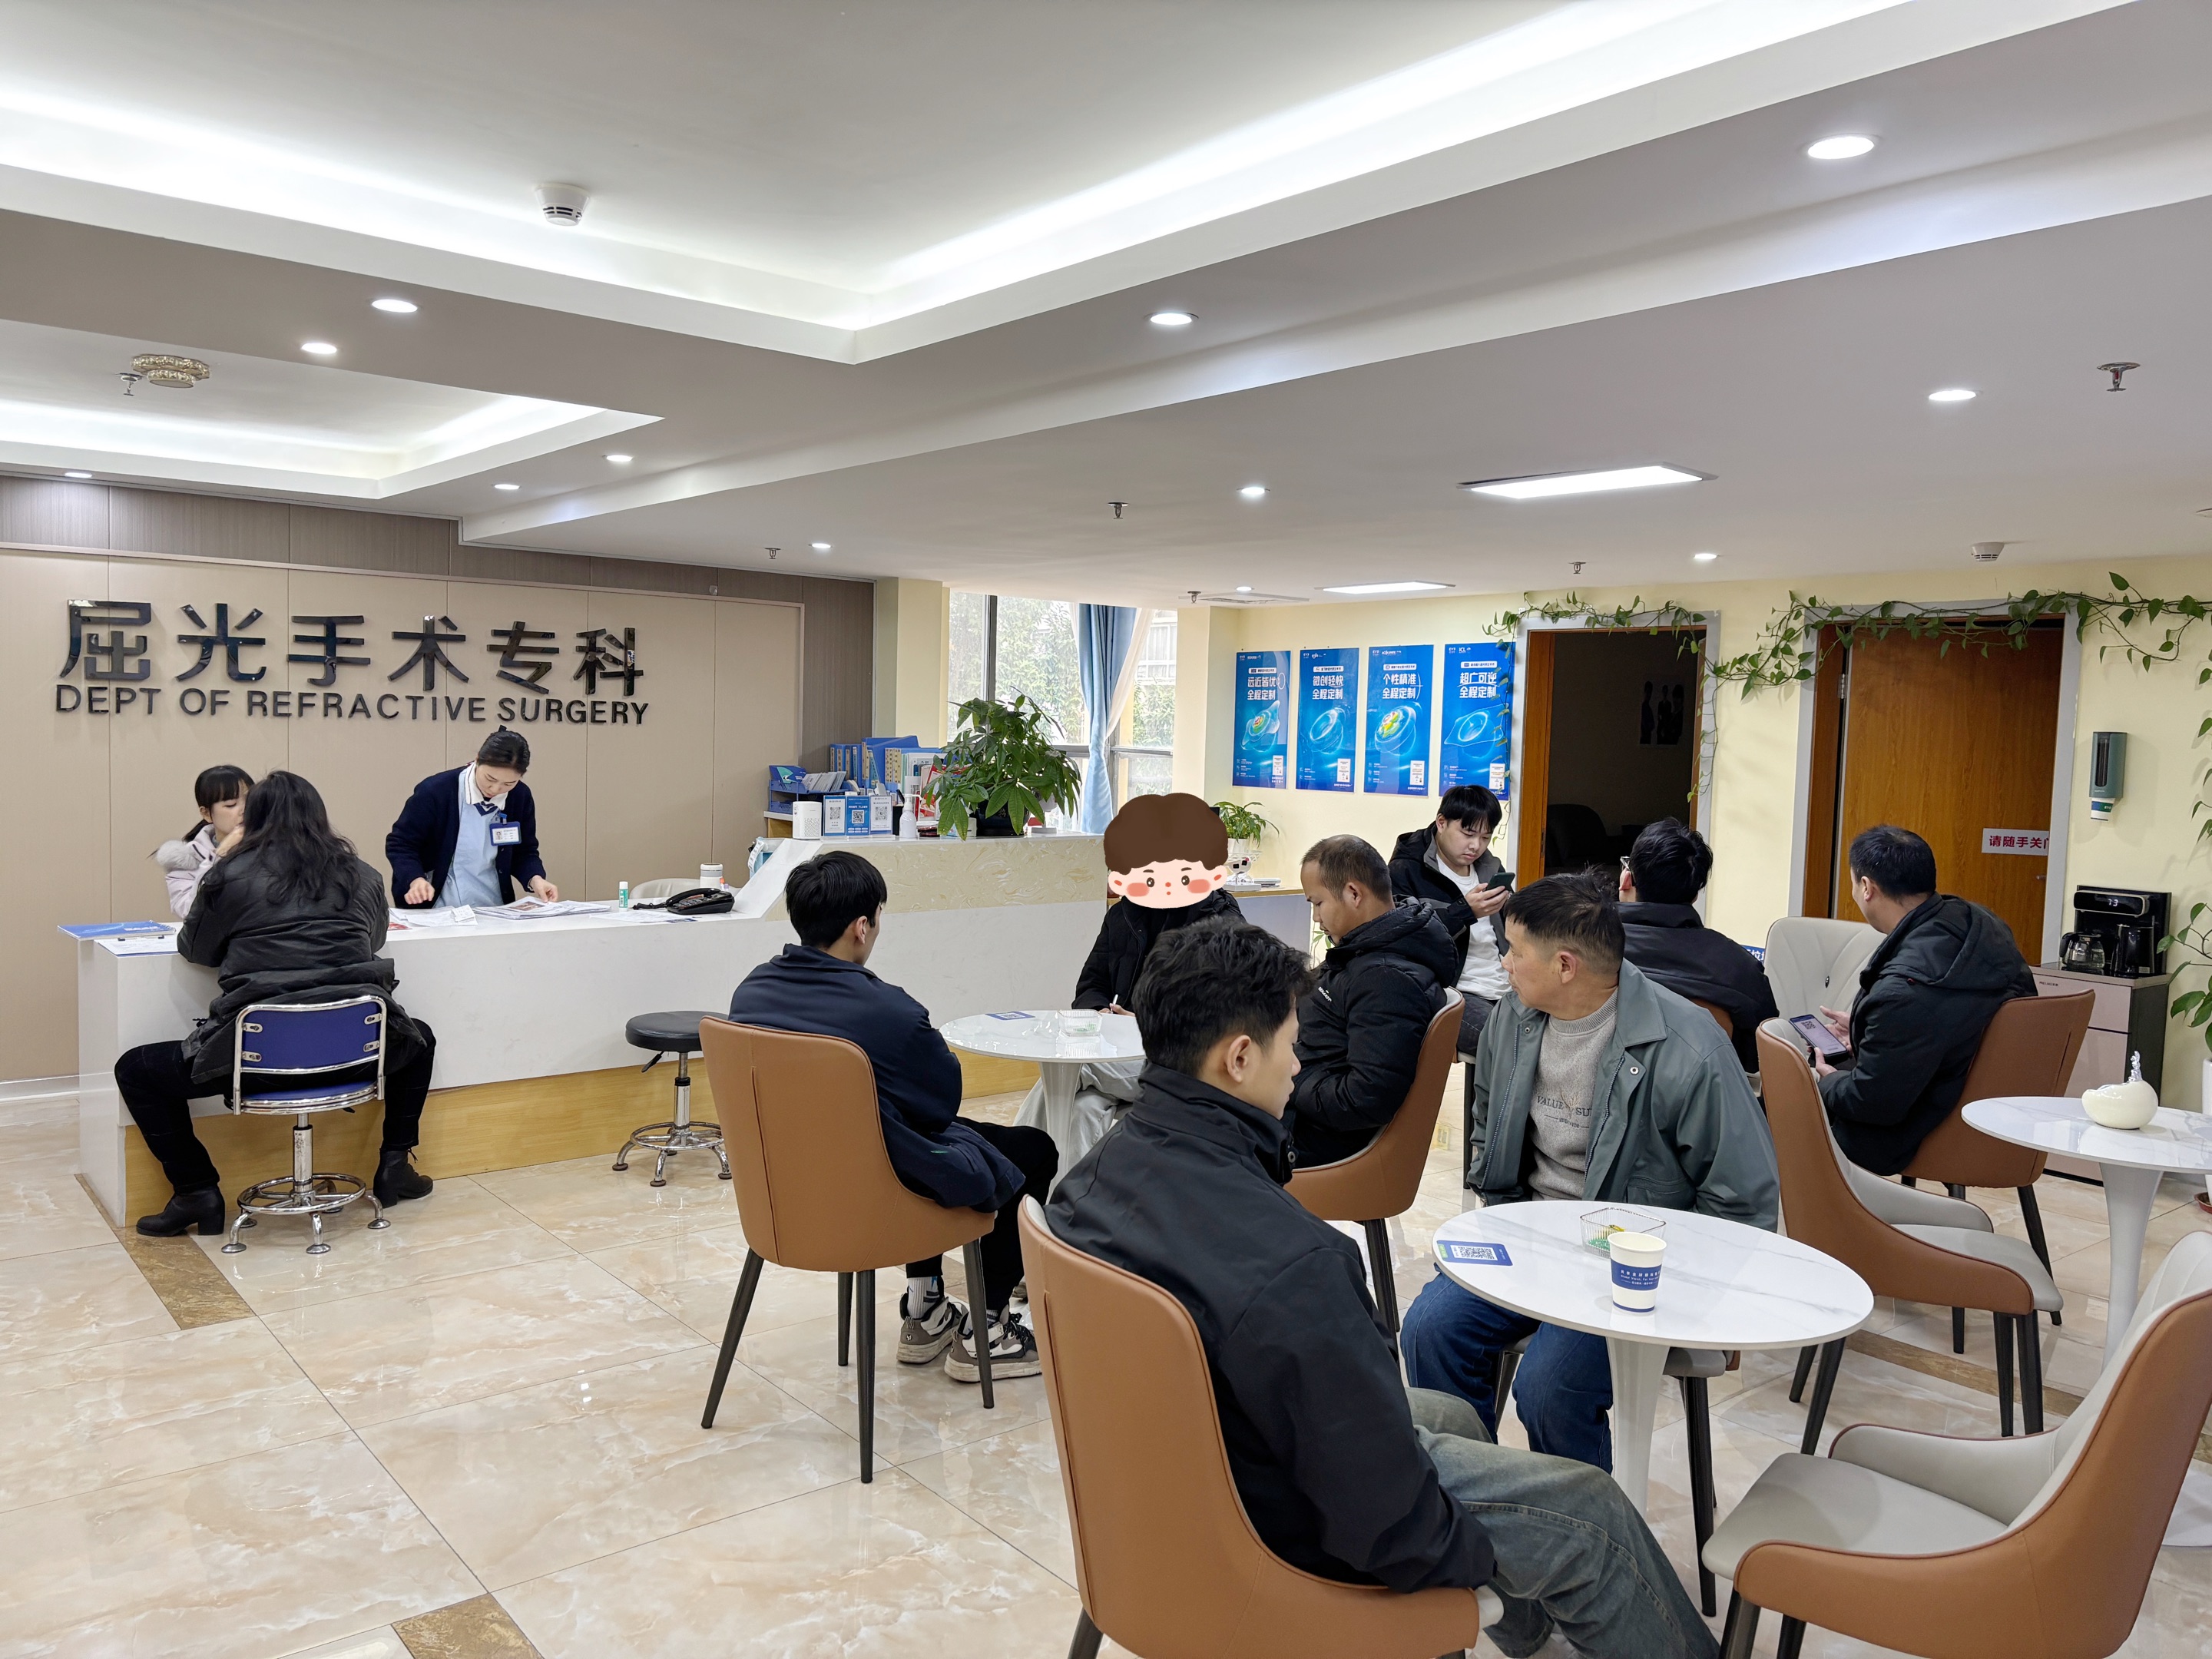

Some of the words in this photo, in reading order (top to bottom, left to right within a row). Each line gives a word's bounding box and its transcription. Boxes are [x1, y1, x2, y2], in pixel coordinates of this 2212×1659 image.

[60, 599, 644, 697] 屈光手术专科
[1247, 677, 1276, 687] 远近皆优
[1313, 675, 1344, 687] 微创轻快
[1383, 673, 1416, 685] 个性精准
[1459, 672, 1497, 684] 超广可逆
[1247, 689, 1276, 700] 全程定制
[1312, 688, 1343, 700] 全程定制
[1382, 687, 1416, 699] 全程定制
[1459, 686, 1497, 699] 全程定制
[56, 684, 161, 714] DEPT
[179, 687, 230, 715] OF
[247, 690, 486, 722] REFRACTIVE
[497, 697, 649, 725] SURGERY
[1537, 1096, 1564, 1110] VALUE
[1576, 1108, 1592, 1117] SU
